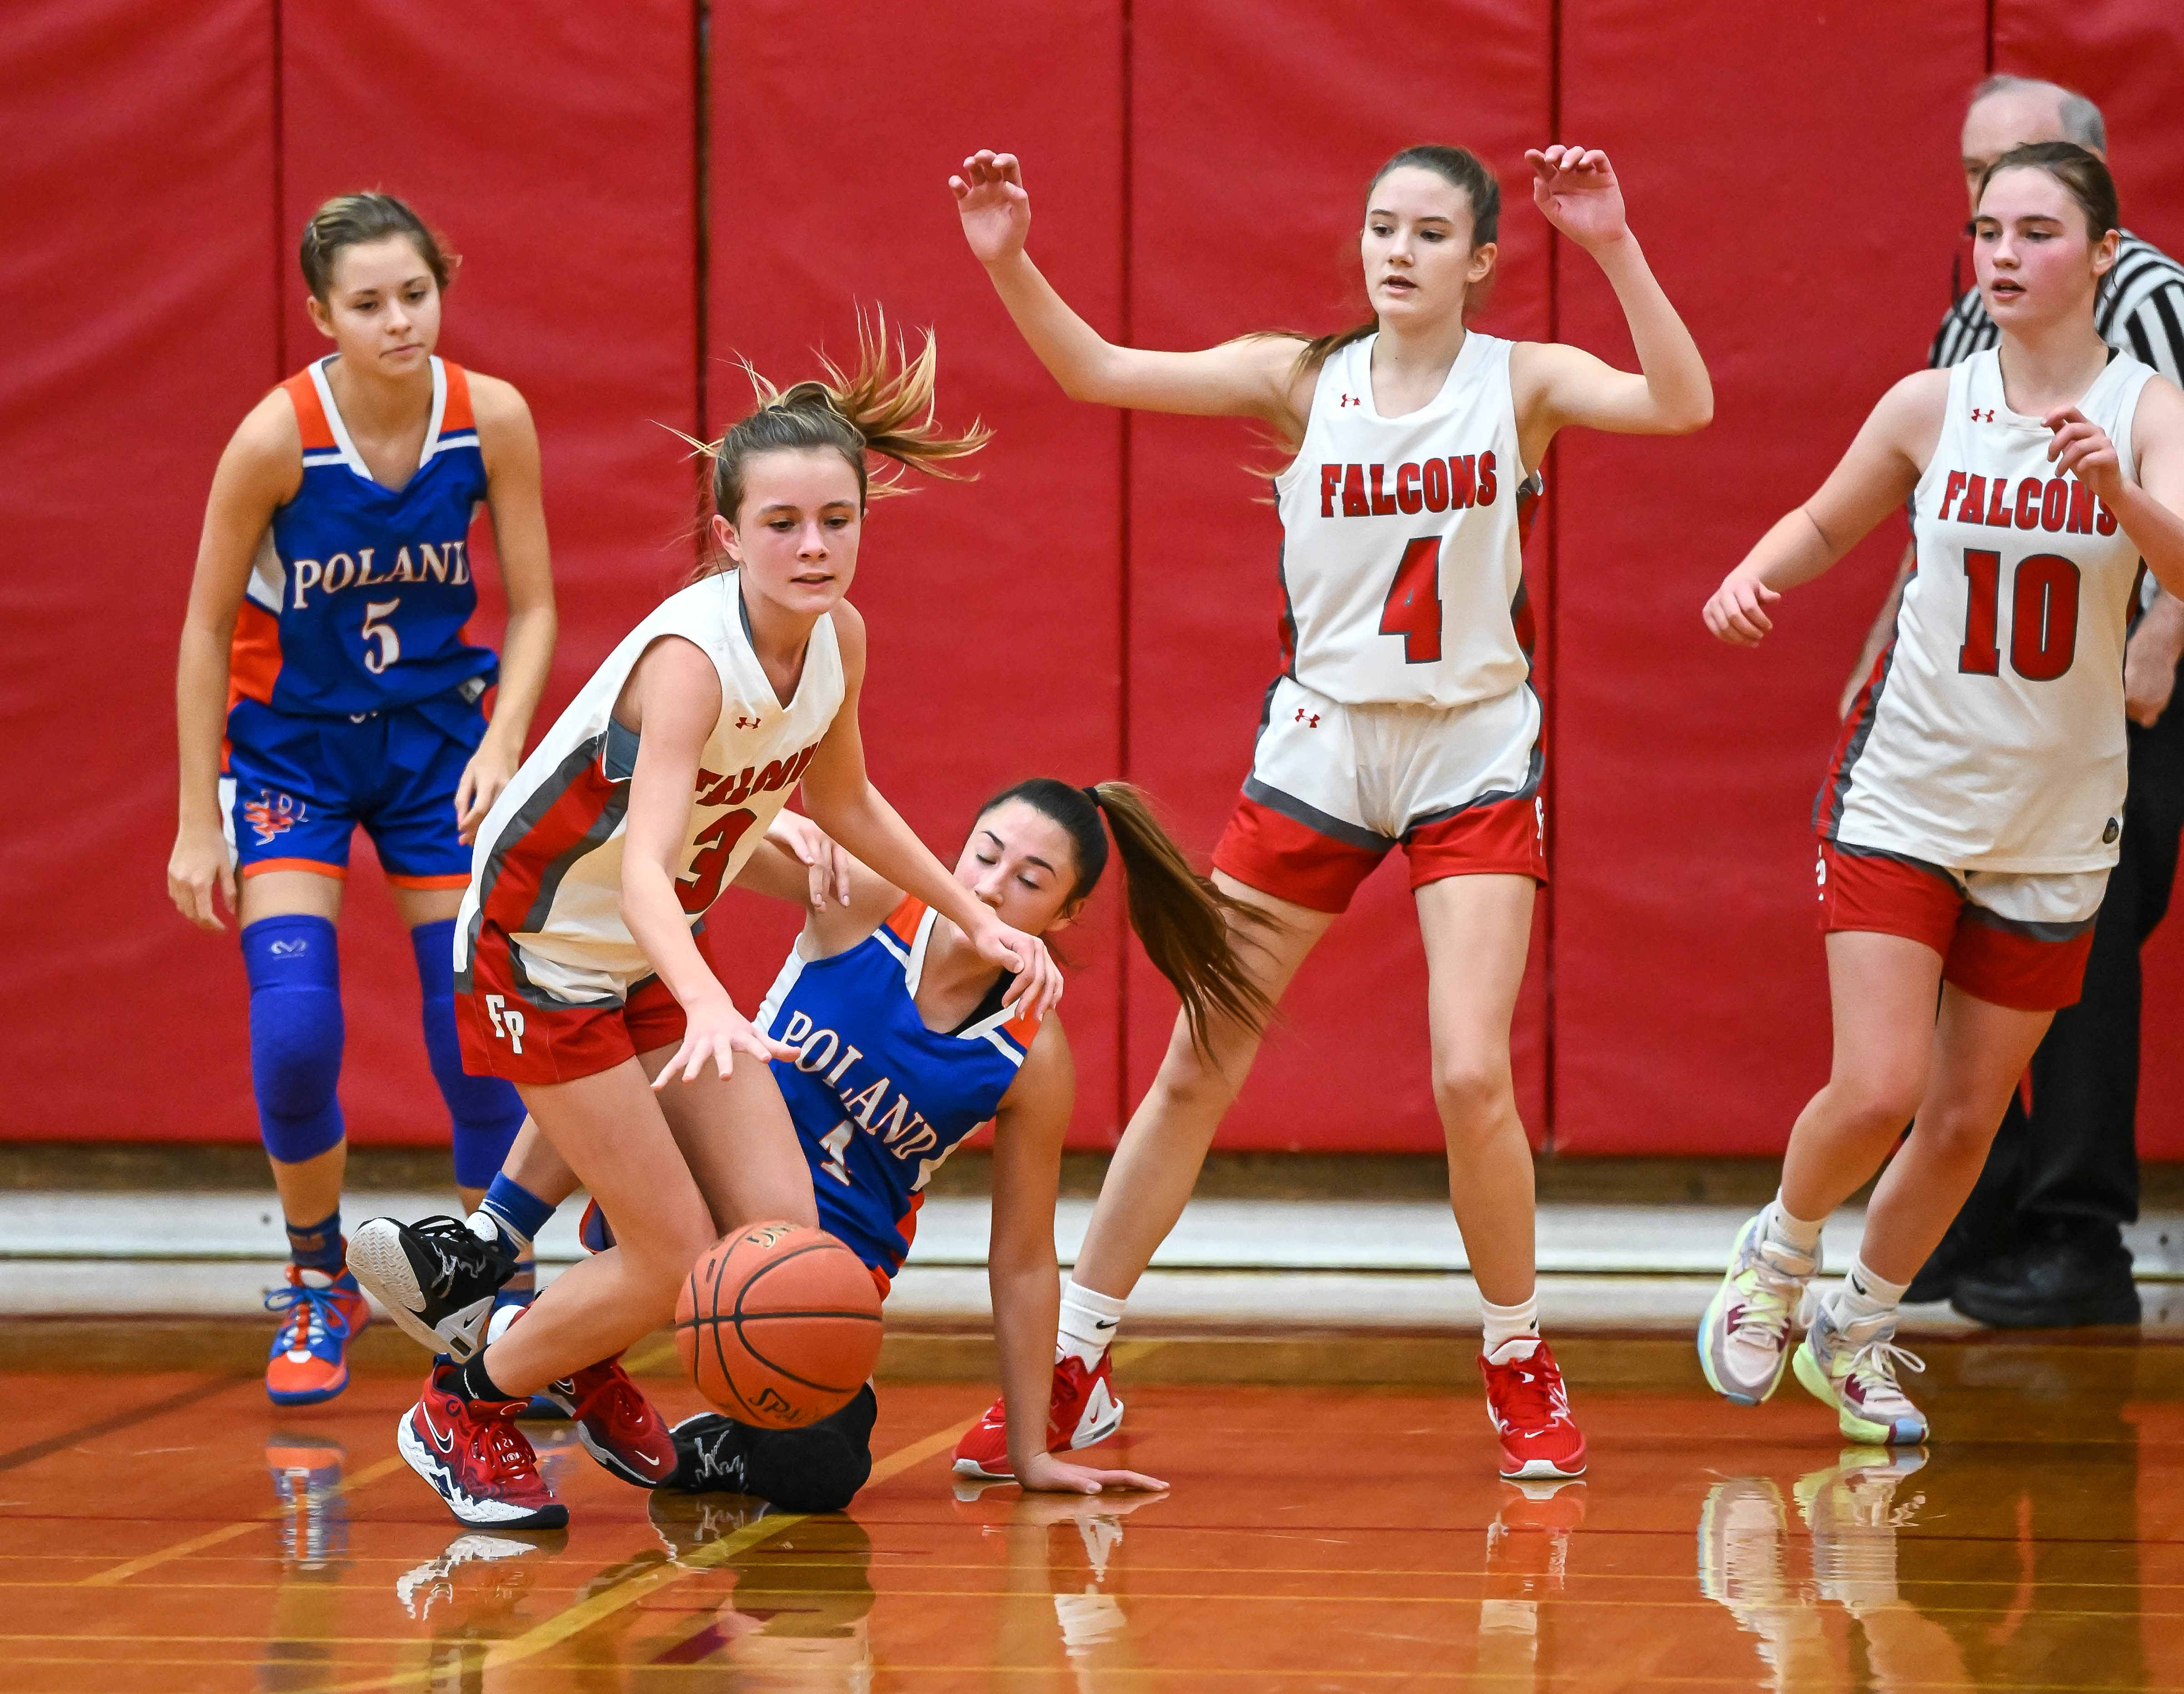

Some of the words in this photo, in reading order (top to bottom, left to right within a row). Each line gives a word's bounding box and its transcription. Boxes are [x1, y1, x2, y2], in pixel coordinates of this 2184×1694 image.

[1321, 450, 1497, 518] FALCONS
[362, 597, 400, 674] 5
[1379, 535, 1442, 664] 4
[1958, 548, 2081, 682] 10
[674, 808, 758, 915] 3
[485, 993, 525, 1054] FP
[780, 1009, 937, 1160] POLAND
